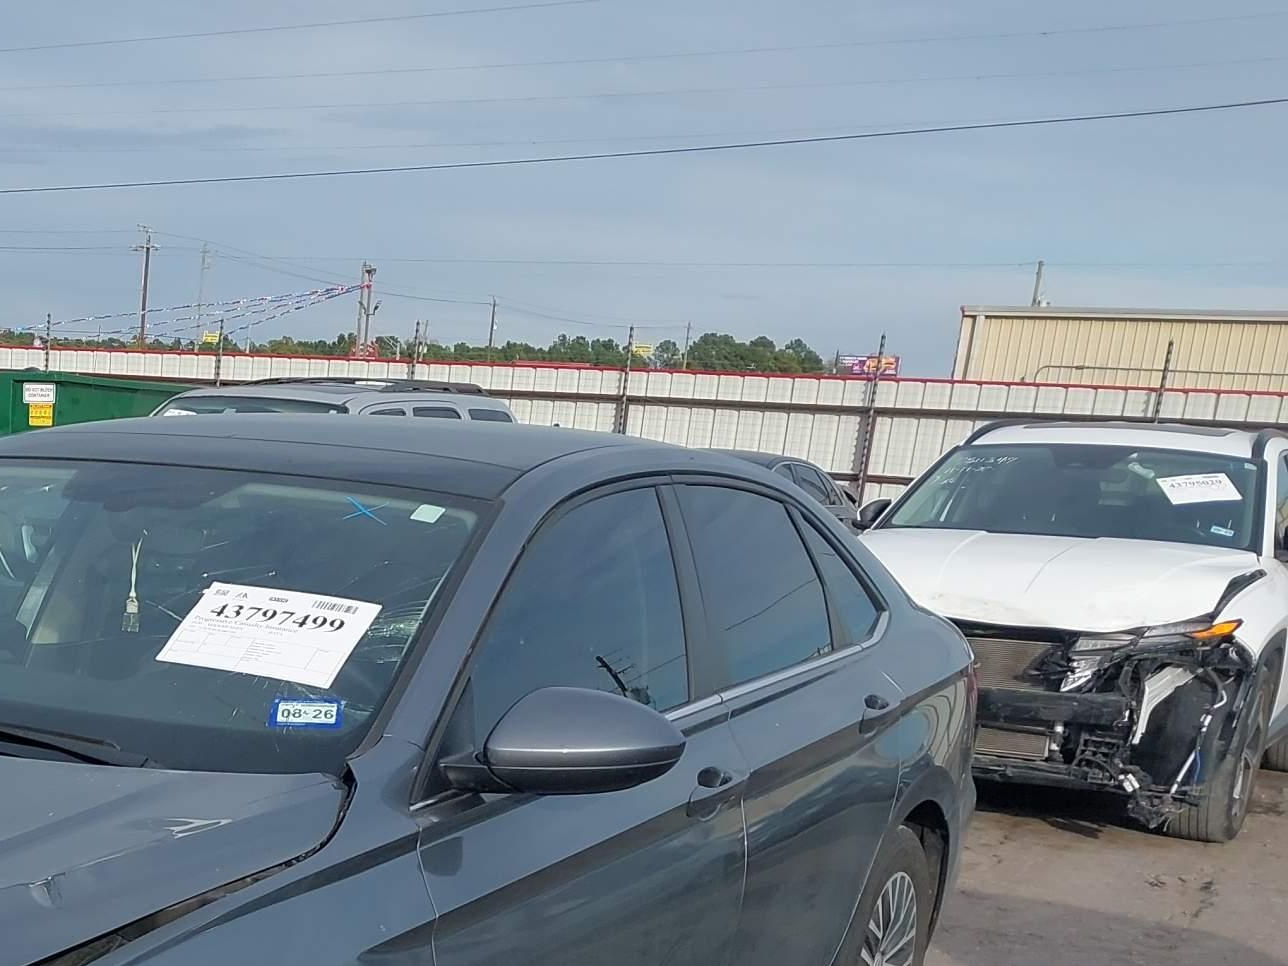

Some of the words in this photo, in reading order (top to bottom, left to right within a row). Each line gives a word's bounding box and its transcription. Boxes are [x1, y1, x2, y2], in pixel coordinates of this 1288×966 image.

[210, 603, 346, 633] 43797499
[281, 708, 302, 719] 08
[312, 708, 334, 720] 26
